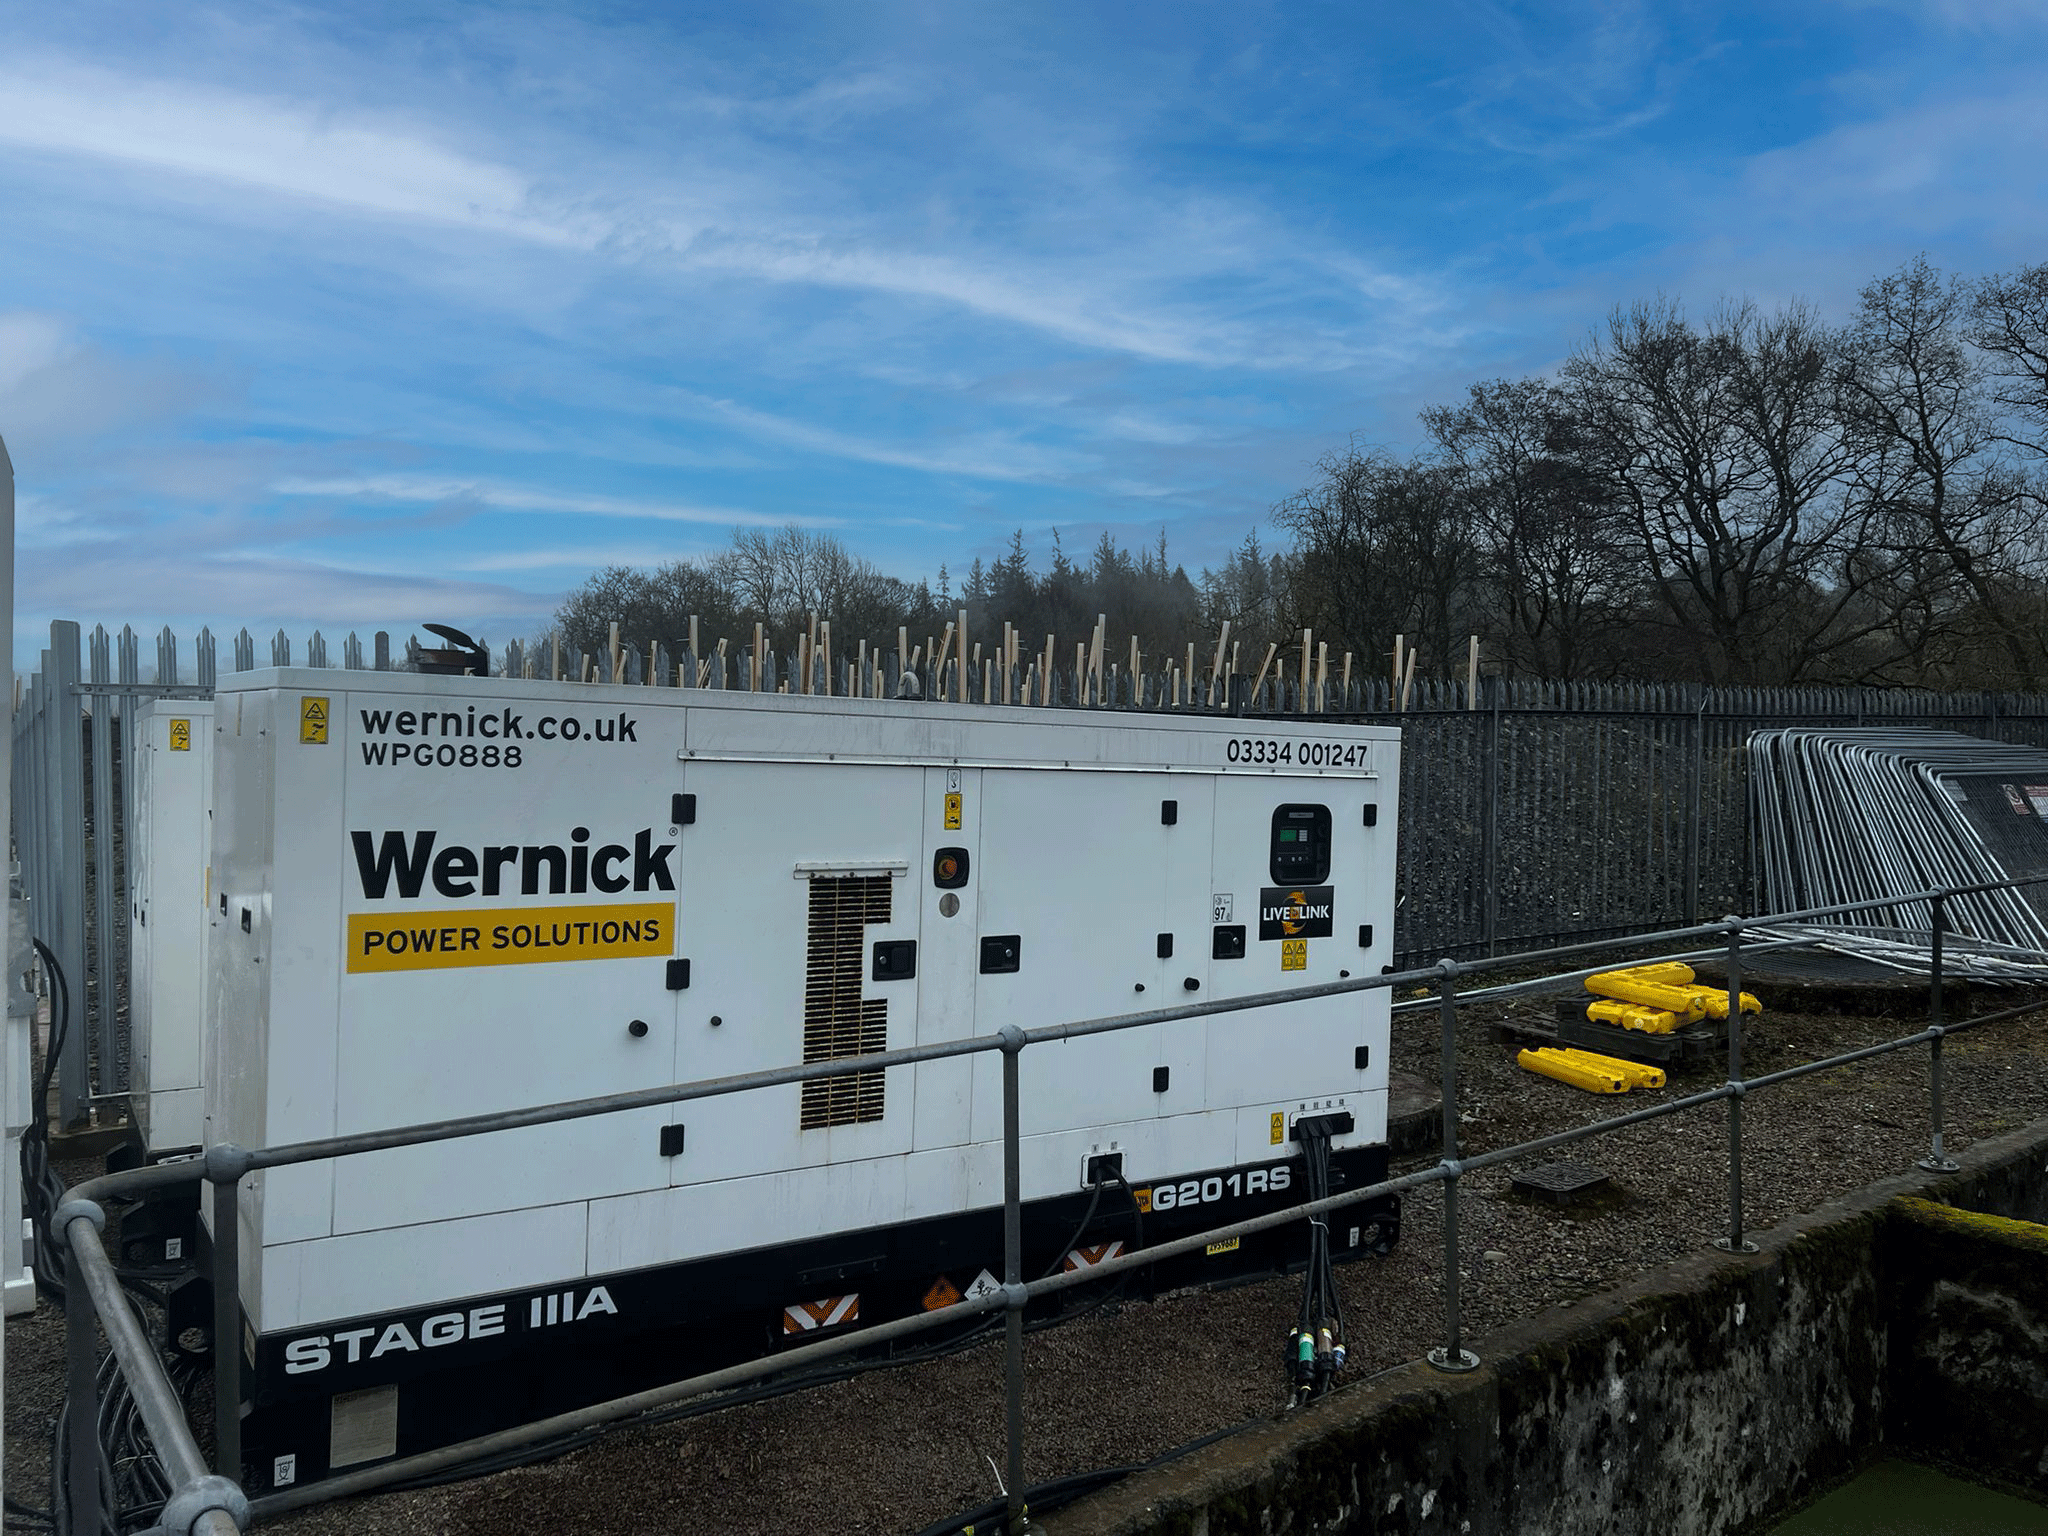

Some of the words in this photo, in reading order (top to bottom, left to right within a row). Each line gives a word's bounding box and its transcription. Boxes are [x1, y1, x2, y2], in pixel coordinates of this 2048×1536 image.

[360, 705, 638, 743] wernick.co.uk
[1227, 739, 1292, 765] 03334
[1298, 743, 1368, 767] 001247
[350, 826, 677, 899] Wernick
[1214, 906, 1226, 921] 97
[363, 927, 480, 955] POWER
[491, 919, 660, 950] SOLUTIONS
[1152, 1165, 1291, 1212] G201RS
[285, 1304, 506, 1375] STAGE
[529, 1285, 619, 1329] IIIA
